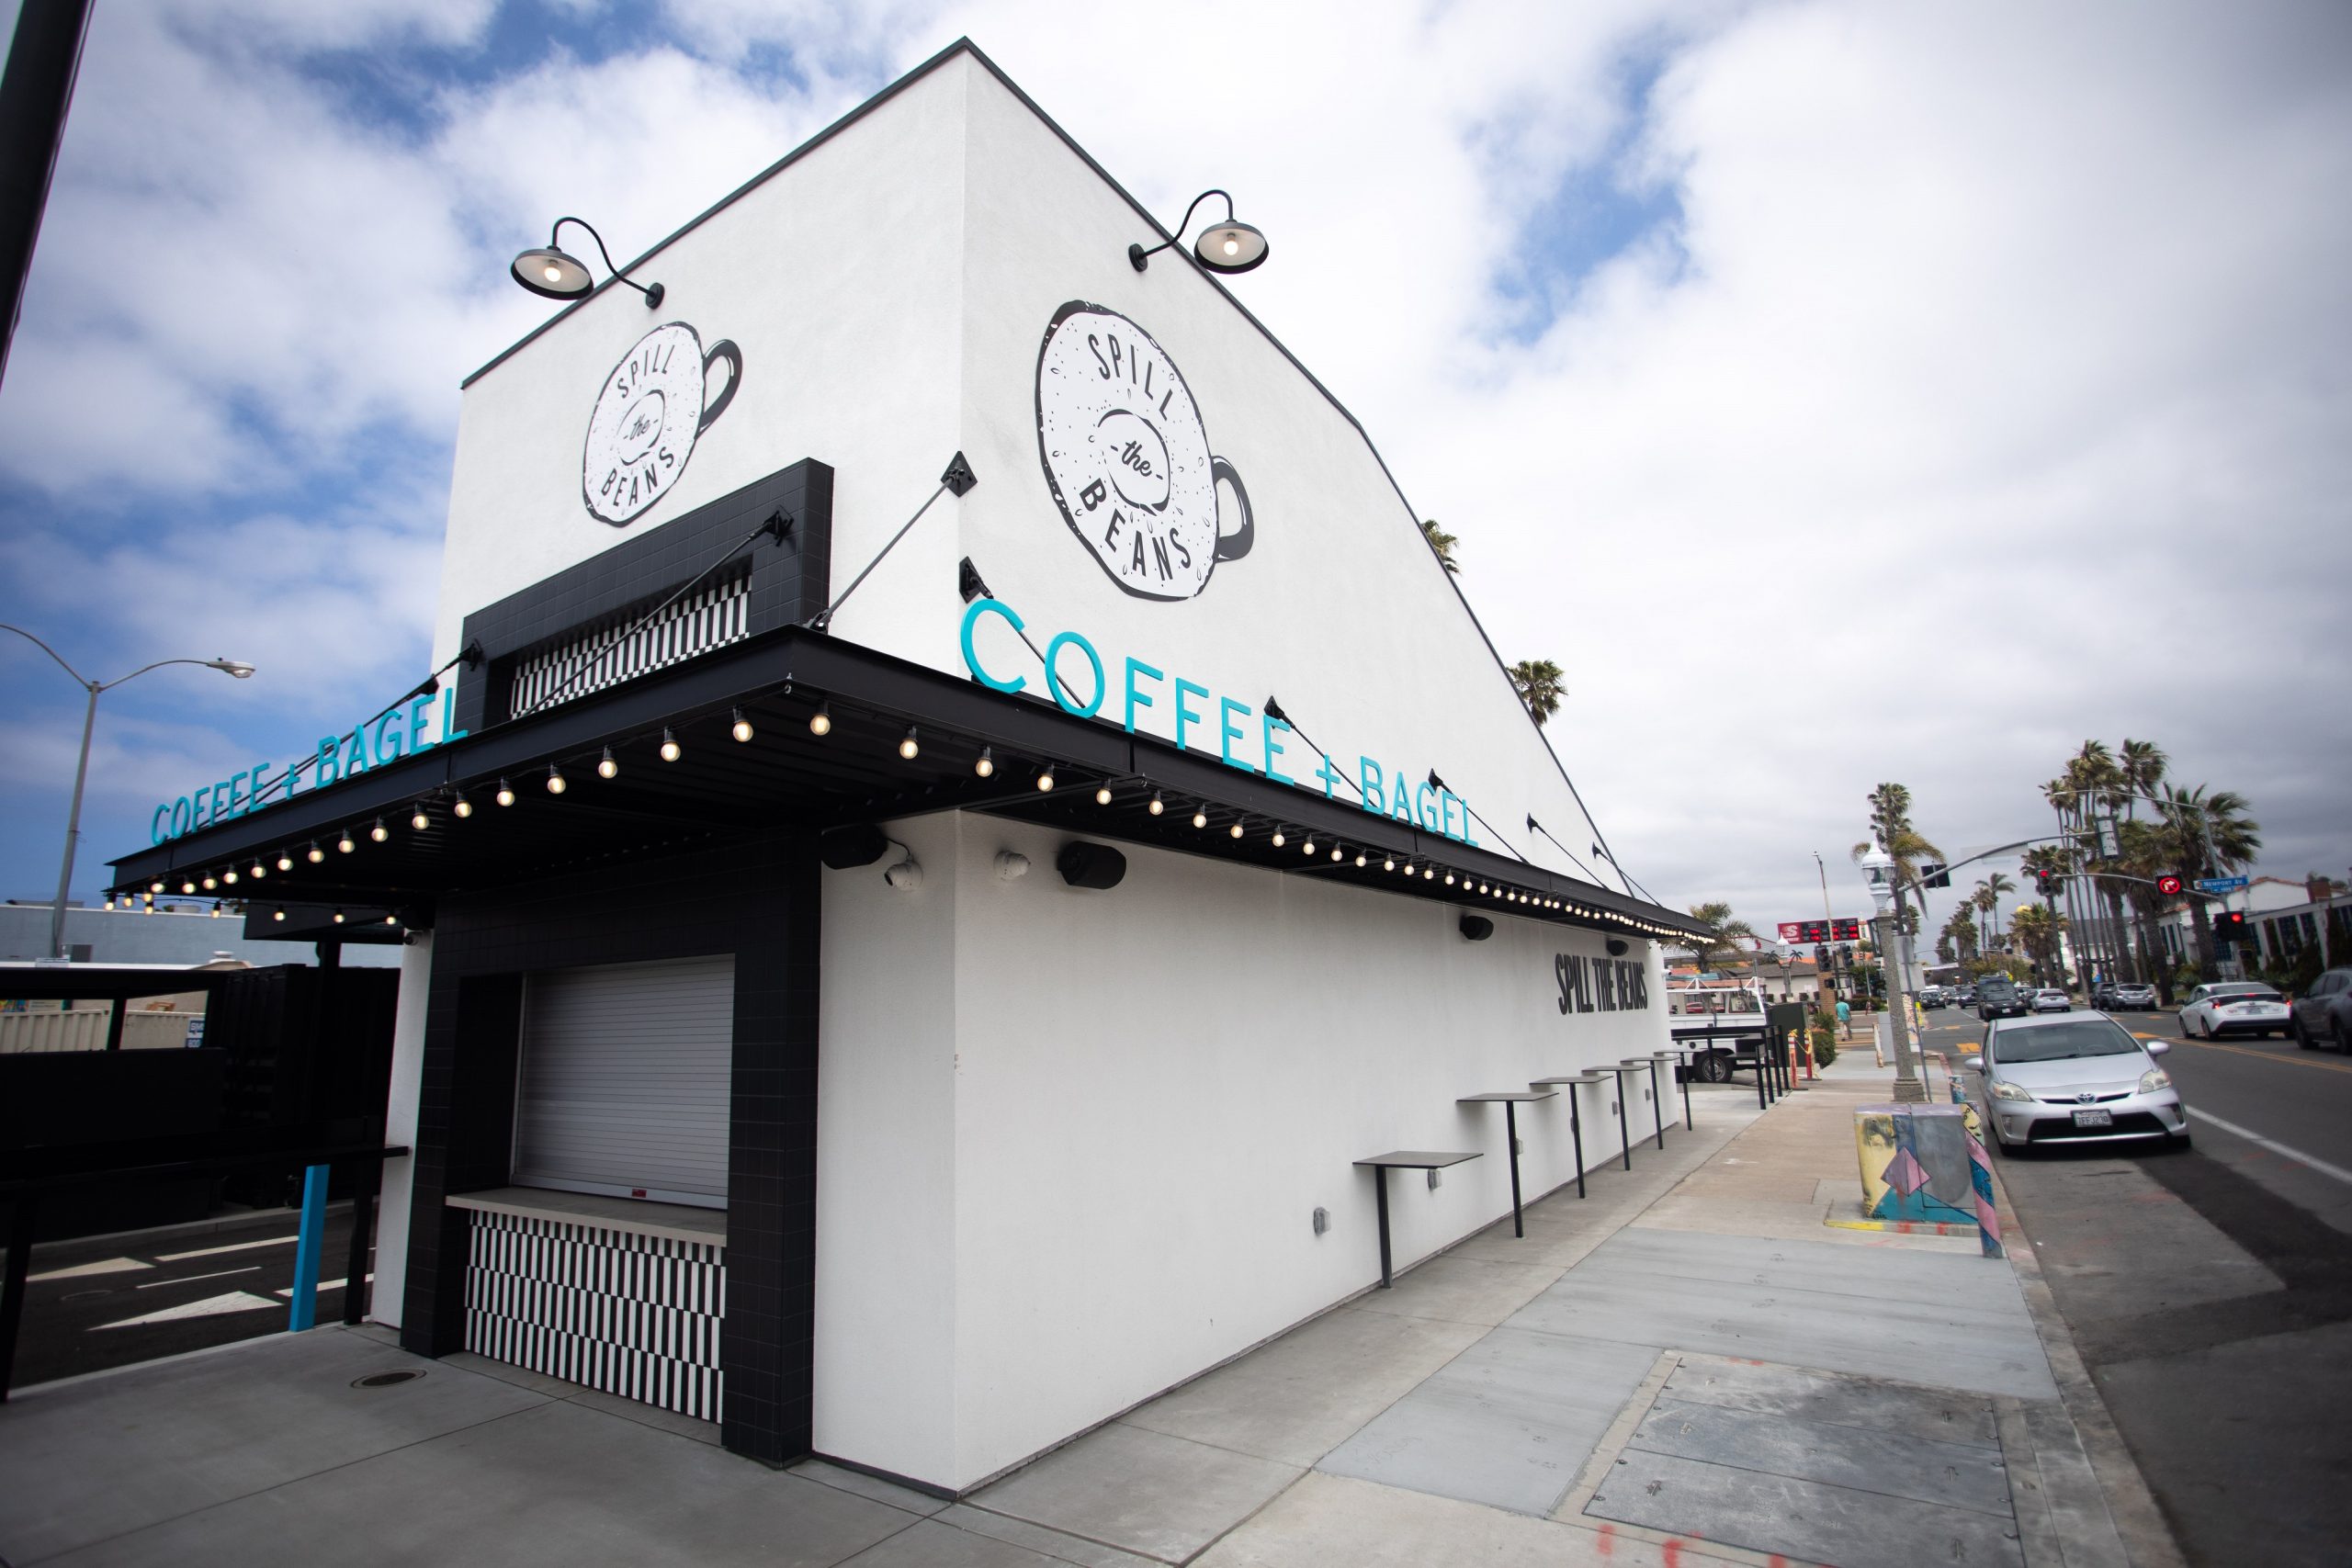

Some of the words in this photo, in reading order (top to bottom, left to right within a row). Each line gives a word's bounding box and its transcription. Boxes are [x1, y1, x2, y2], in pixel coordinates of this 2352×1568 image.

[617, 344, 675, 399] SPILL
[1088, 333, 1173, 422] SPILL
[601, 446, 674, 507] BEANS
[1080, 478, 1192, 581] BEANS
[151, 761, 271, 847] COFFEE
[315, 687, 469, 790] BAGEL
[960, 598, 1295, 786] COFFEE
[1361, 755, 1478, 848] BAGEL
[1555, 953, 1595, 1015] SPILL
[1591, 957, 1617, 1012] THE
[1614, 960, 1648, 1011] BEANS
